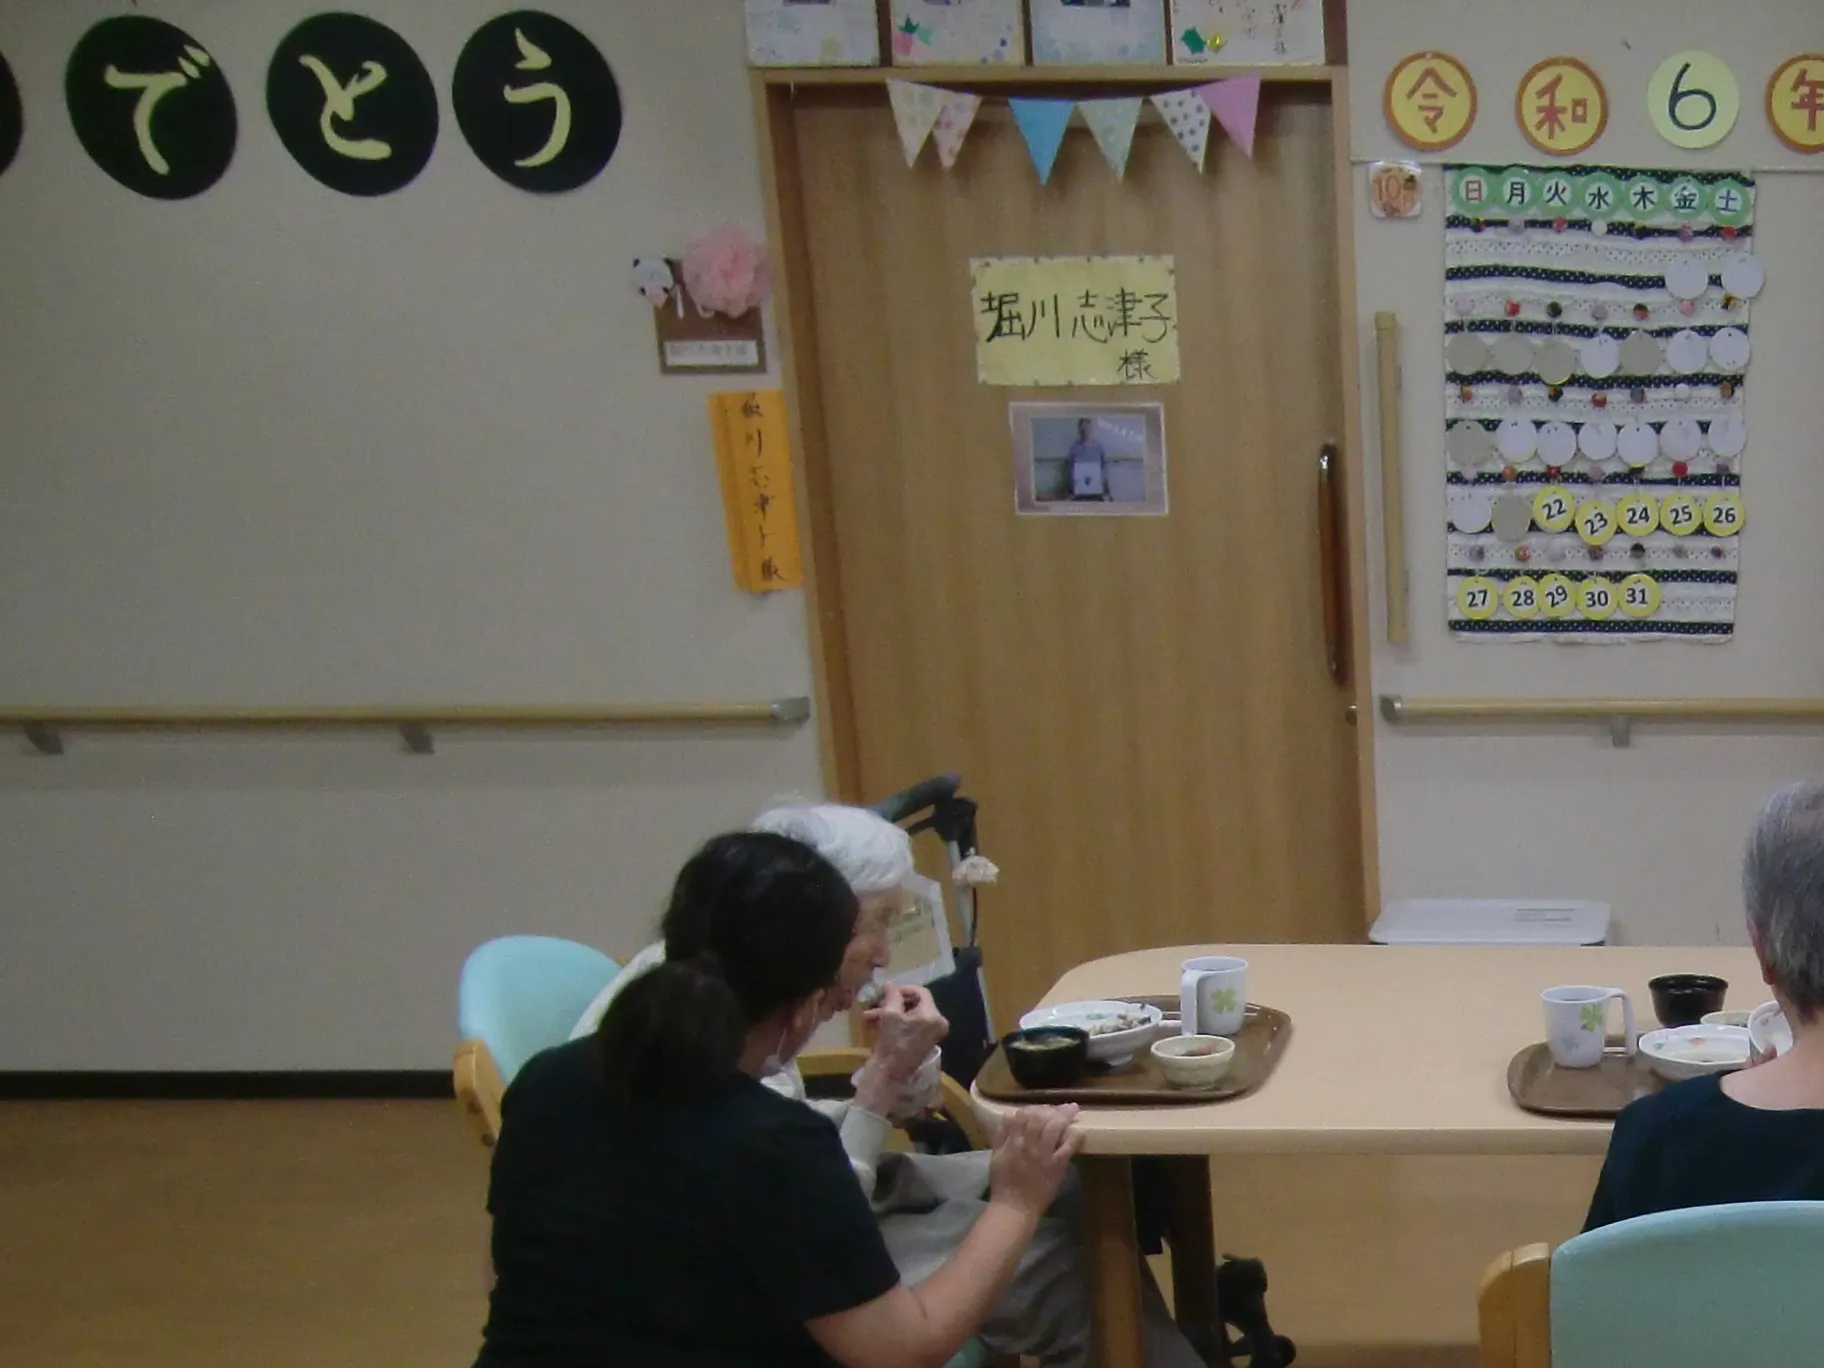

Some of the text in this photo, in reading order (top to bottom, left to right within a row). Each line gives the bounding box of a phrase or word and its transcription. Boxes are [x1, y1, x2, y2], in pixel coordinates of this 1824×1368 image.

[1465, 180, 1739, 212] 日 月 火 水 木 金 土
[1117, 348, 1158, 380] 様
[1541, 498, 1736, 535] 22 23 24 25 26
[1466, 585, 1648, 608] 27 28 29 30 31
